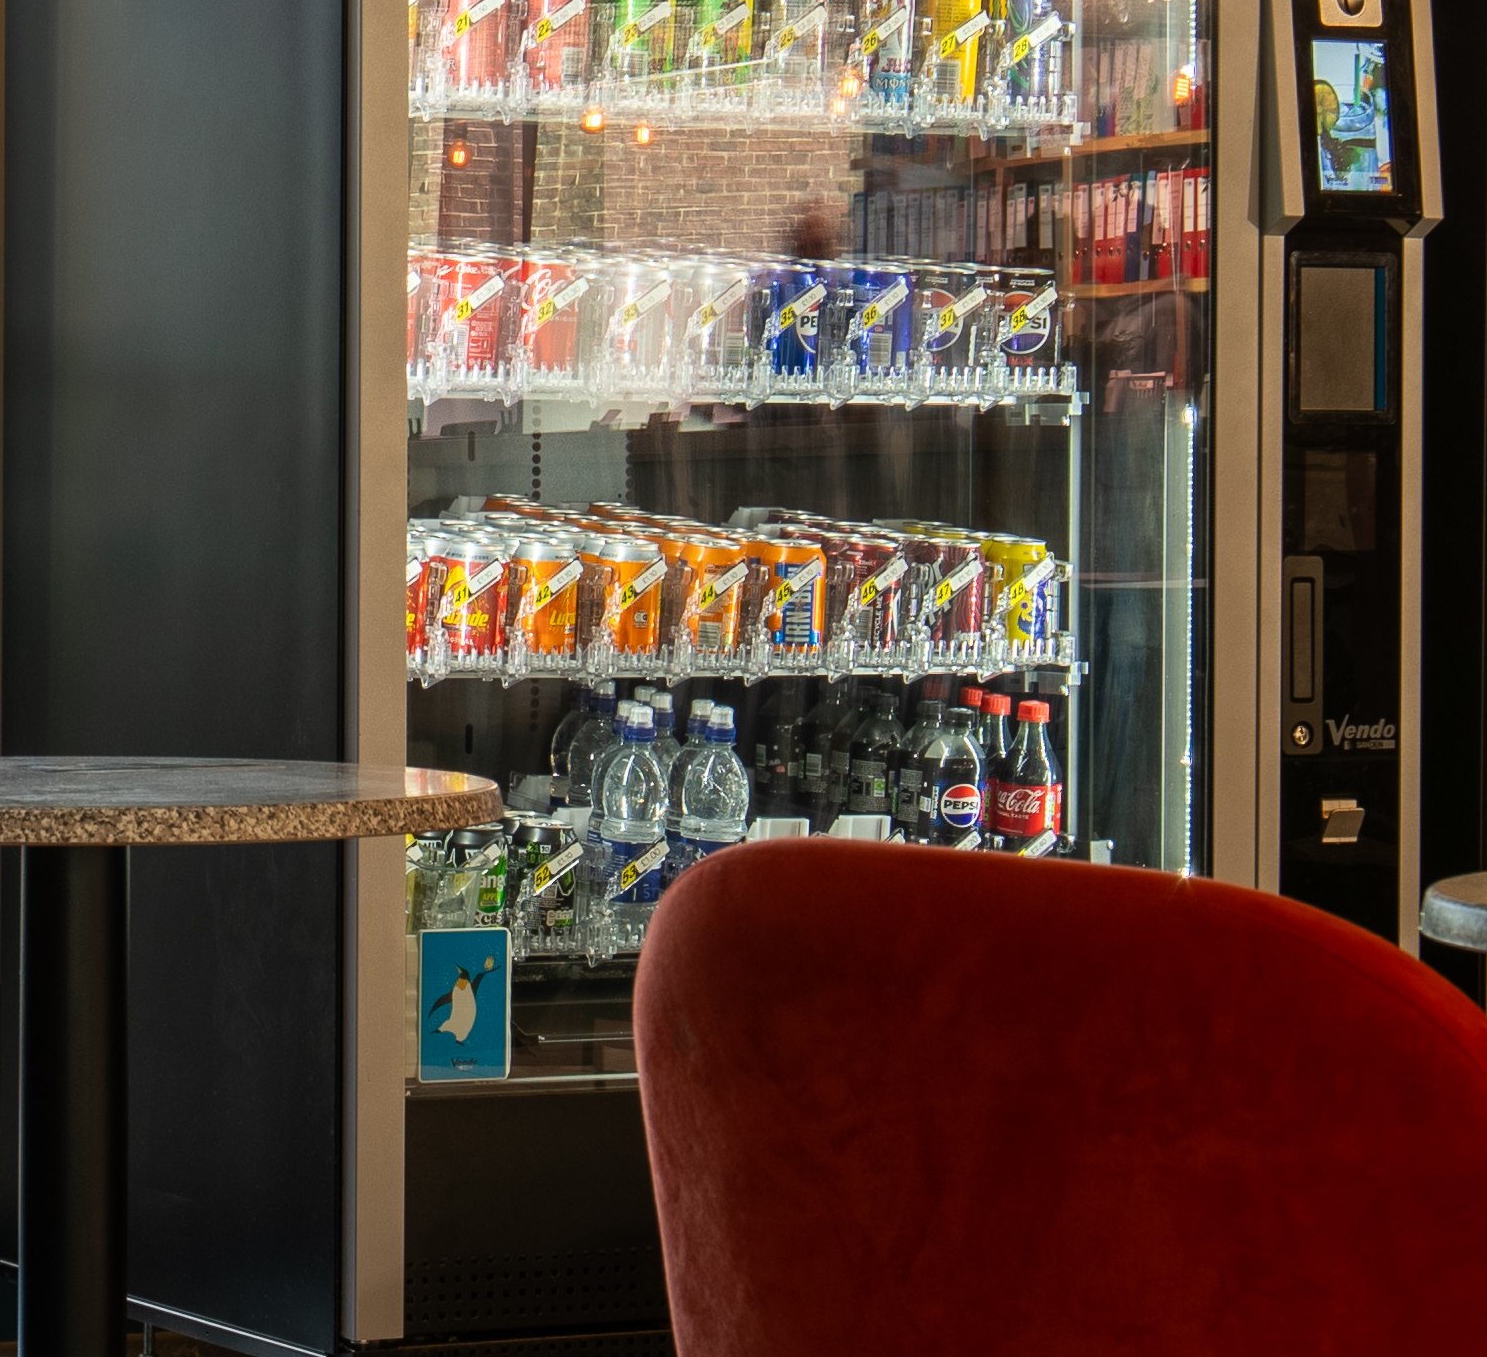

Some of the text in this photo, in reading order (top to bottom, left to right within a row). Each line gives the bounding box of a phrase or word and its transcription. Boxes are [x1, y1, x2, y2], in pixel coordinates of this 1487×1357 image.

[456, 17, 469, 33] 21
[538, 21, 551, 38] 22
[862, 34, 877, 52] 26
[940, 34, 954, 53] 27
[1014, 40, 1027, 59] 28
[457, 302, 470, 320] 31
[538, 302, 552, 320] 32
[780, 308, 794, 325] 35
[863, 305, 877, 325] 36
[940, 308, 954, 328] 37
[455, 587, 467, 603] 41
[536, 586, 550, 603] 42
[621, 586, 635, 605] 43
[700, 584, 715, 604] 44
[777, 585, 791, 603] 45
[861, 581, 875, 601] 46
[937, 583, 950, 601] 47
[1011, 583, 1025, 602] 48
[1325, 714, 1395, 746] Vendo
[621, 847, 662, 886] 53 £1.00
[479, 875, 506, 891] ang
[535, 867, 550, 888] 52
